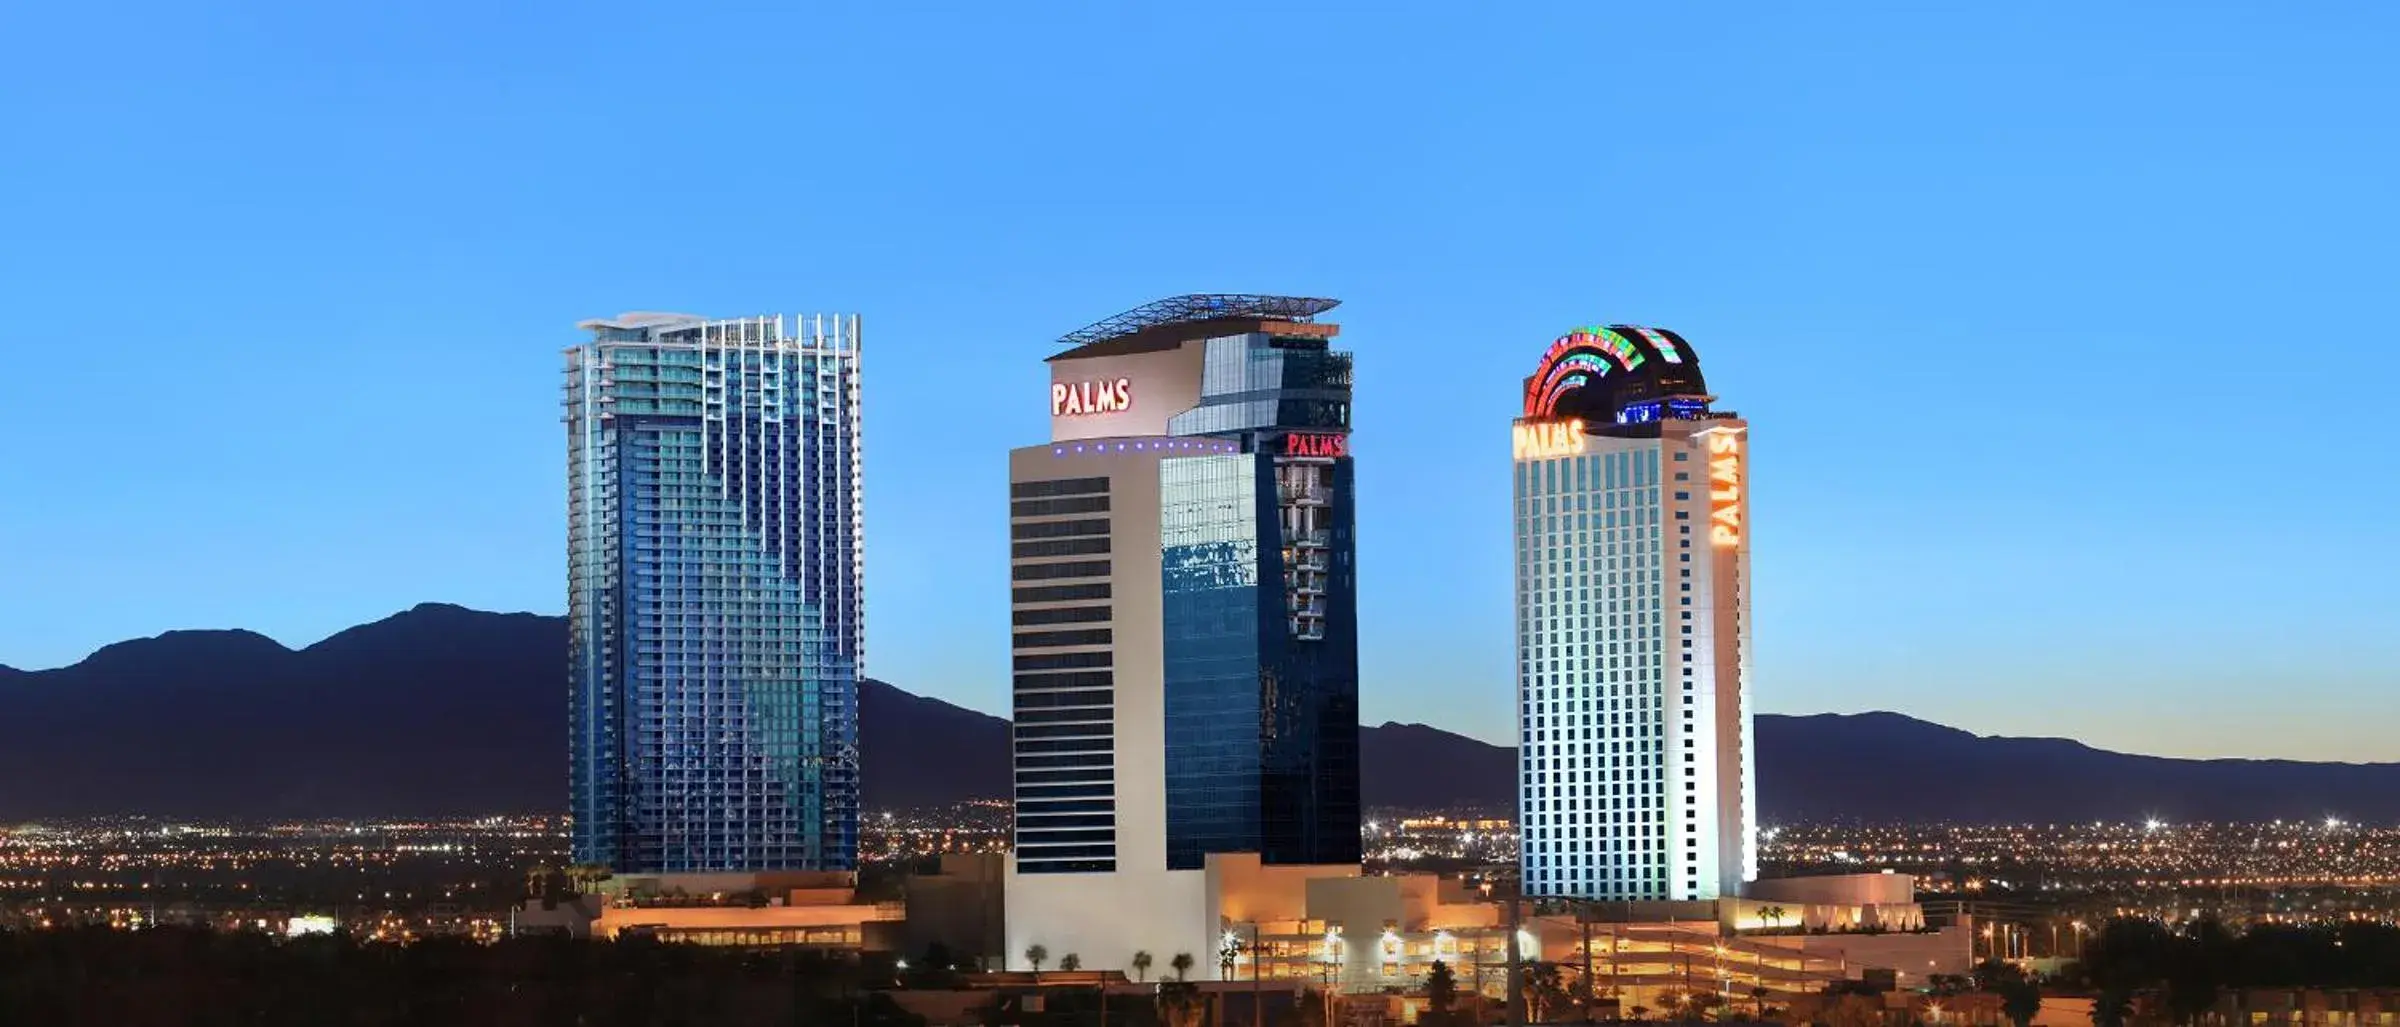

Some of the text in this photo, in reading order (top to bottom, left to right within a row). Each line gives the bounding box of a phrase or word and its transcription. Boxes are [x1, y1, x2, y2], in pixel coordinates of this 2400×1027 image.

[1052, 379, 1131, 416] PALMS
[1287, 433, 1345, 457] PALMS
[1513, 418, 1585, 460] PALMS
[1711, 434, 1741, 546] PALMS
